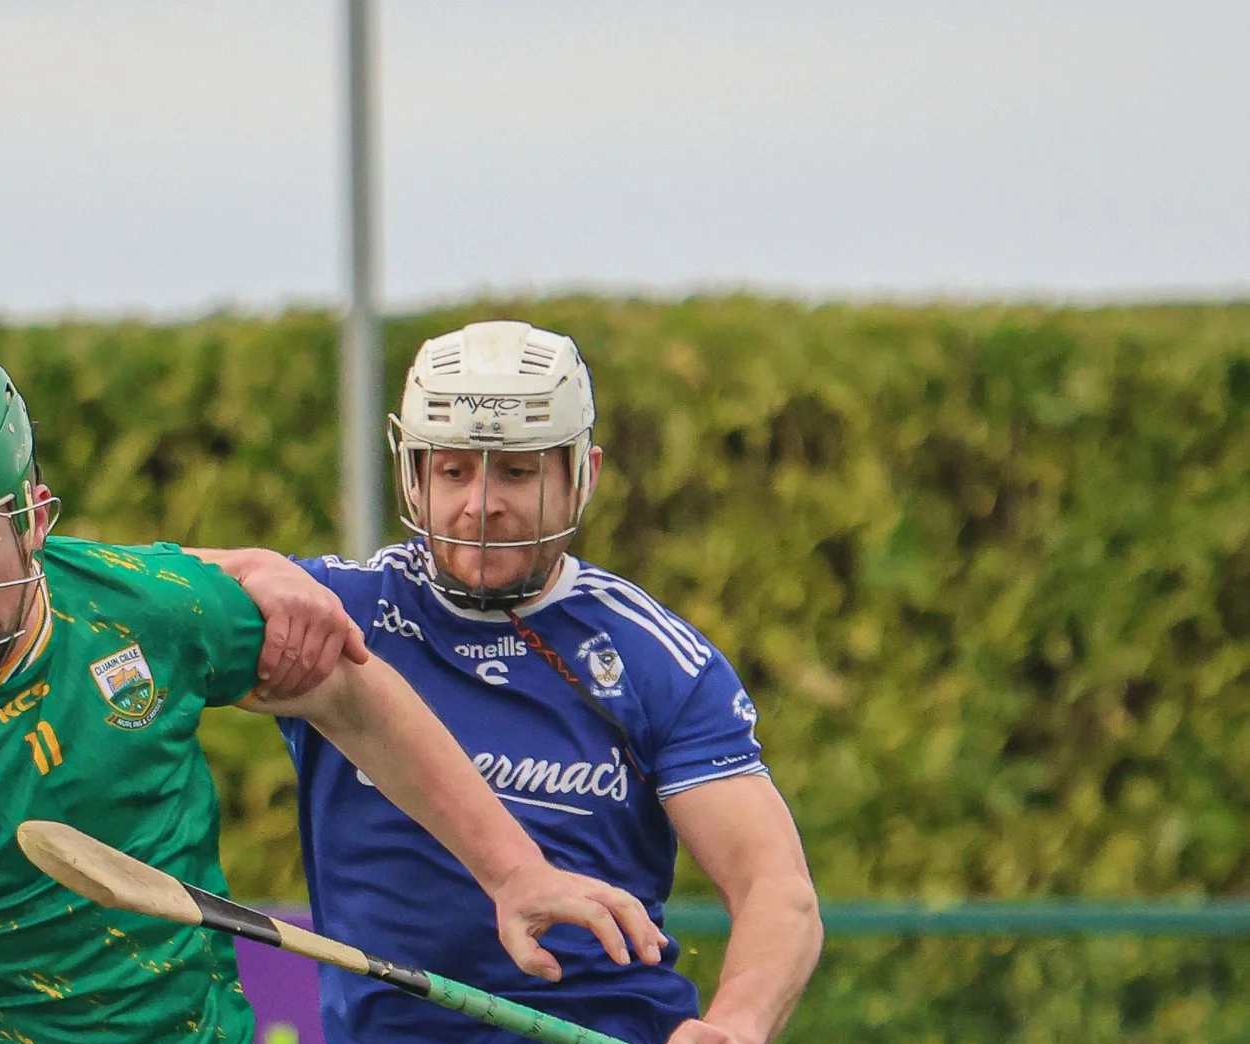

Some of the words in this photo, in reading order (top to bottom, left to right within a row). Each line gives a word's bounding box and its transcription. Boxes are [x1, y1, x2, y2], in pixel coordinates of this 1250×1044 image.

[94, 658, 120, 676] CLUAIN
[119, 648, 140, 663] CILLE
[24, 720, 64, 776] 11
